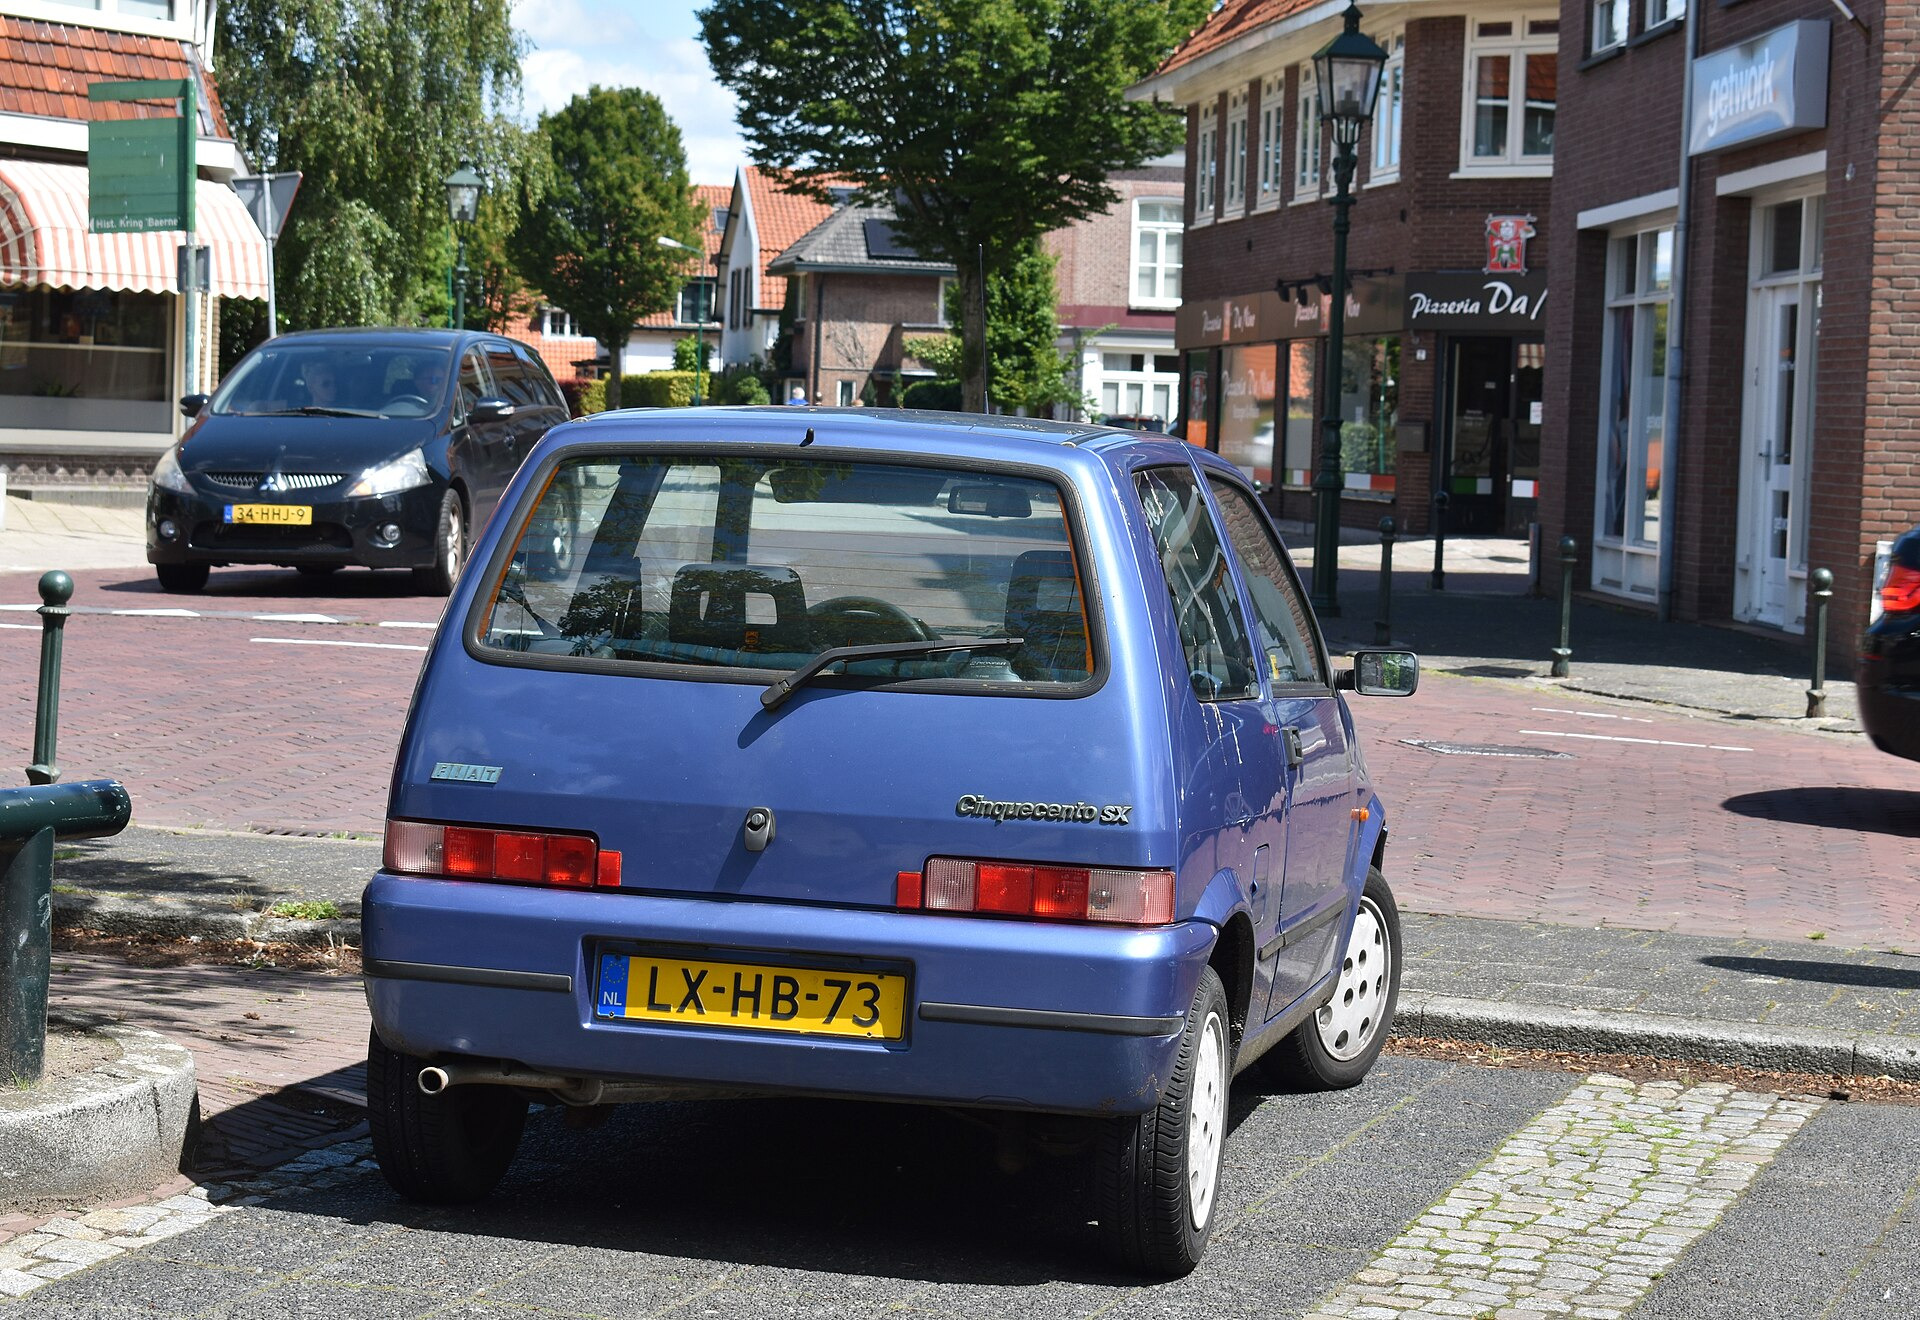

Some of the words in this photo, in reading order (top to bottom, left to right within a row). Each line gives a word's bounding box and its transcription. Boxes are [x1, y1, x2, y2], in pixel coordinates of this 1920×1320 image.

[96, 219, 117, 229] Hist.
[120, 218, 143, 230] Kring
[1409, 293, 1481, 319] Pizzeria
[1483, 281, 1529, 315] Da
[237, 507, 305, 521] 34-HHJ-9
[434, 763, 499, 781] FIAT
[957, 794, 1098, 823] Cinquecento
[603, 990, 622, 1006] NL
[647, 965, 882, 1028] LX-HB-73
